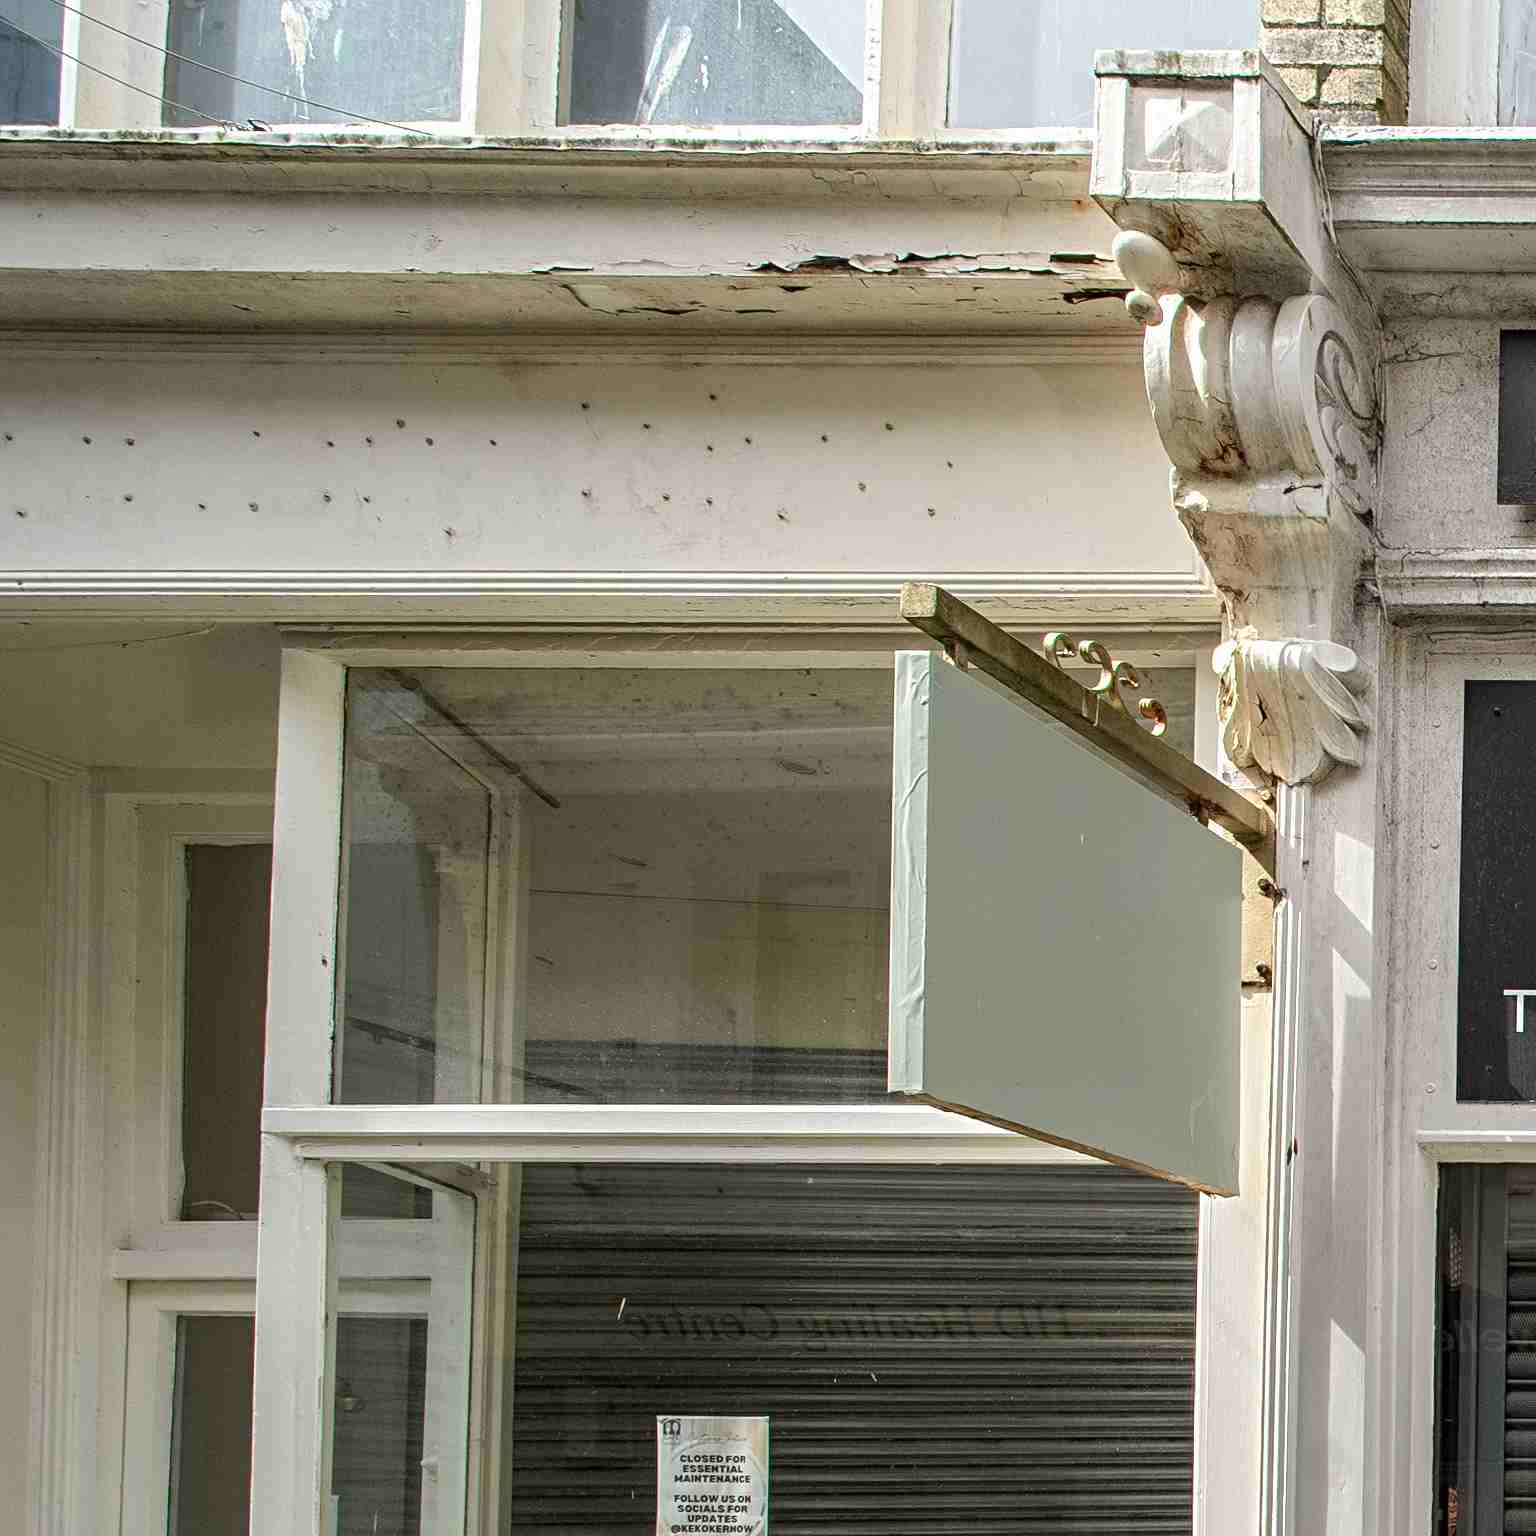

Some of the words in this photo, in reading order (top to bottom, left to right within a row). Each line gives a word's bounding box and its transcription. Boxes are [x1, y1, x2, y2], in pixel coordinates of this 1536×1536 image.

[680, 1455, 723, 1463] CLOSED
[726, 1455, 746, 1463] FOR
[683, 1465, 743, 1473] ESSENTIAL
[674, 1475, 751, 1483] MAINTENANCE
[674, 1495, 721, 1503] FOLLOW
[722, 1495, 736, 1503] US
[738, 1495, 751, 1503] ON
[677, 1505, 724, 1513] SOCIALS
[727, 1505, 748, 1513] FOR
[687, 1515, 737, 1523] UPDATES
